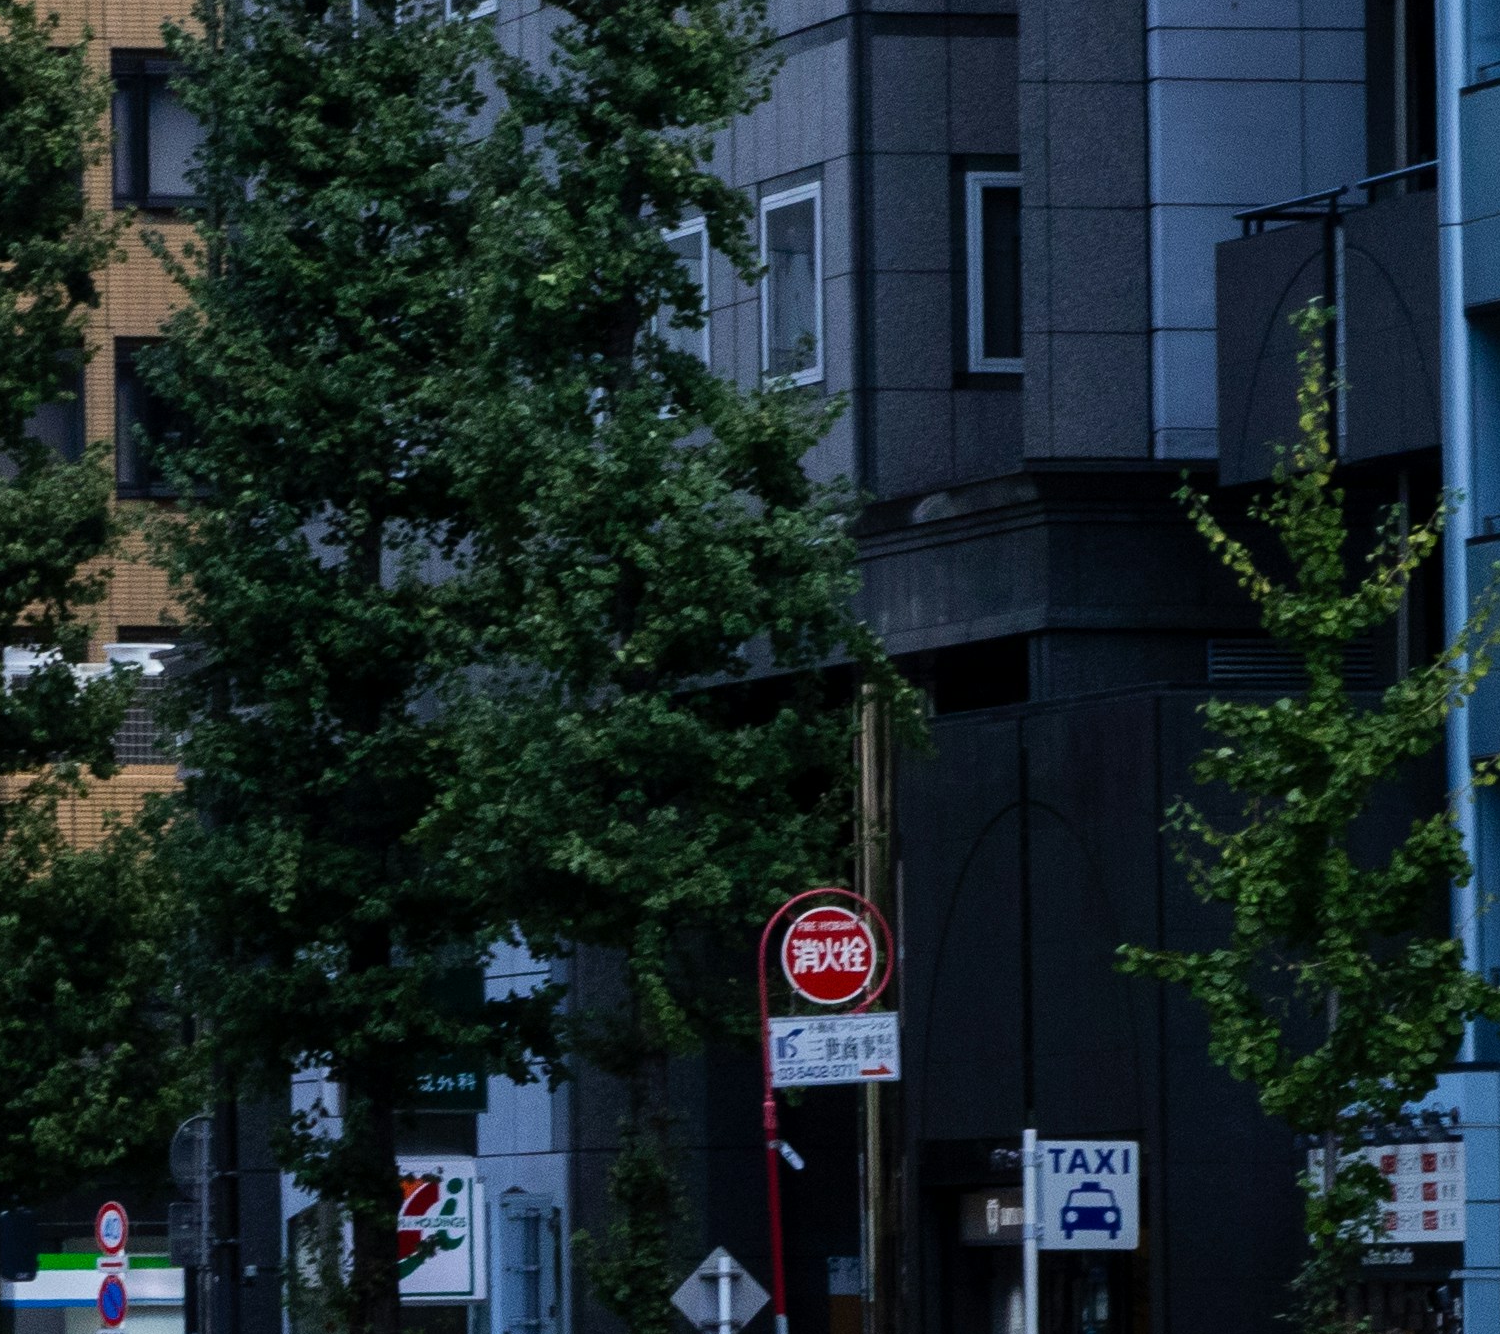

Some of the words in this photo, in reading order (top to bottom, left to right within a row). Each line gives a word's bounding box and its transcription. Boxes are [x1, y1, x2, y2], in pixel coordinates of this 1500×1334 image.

[791, 936, 868, 974] 消火栓
[1047, 1148, 1131, 1175] TAXI
